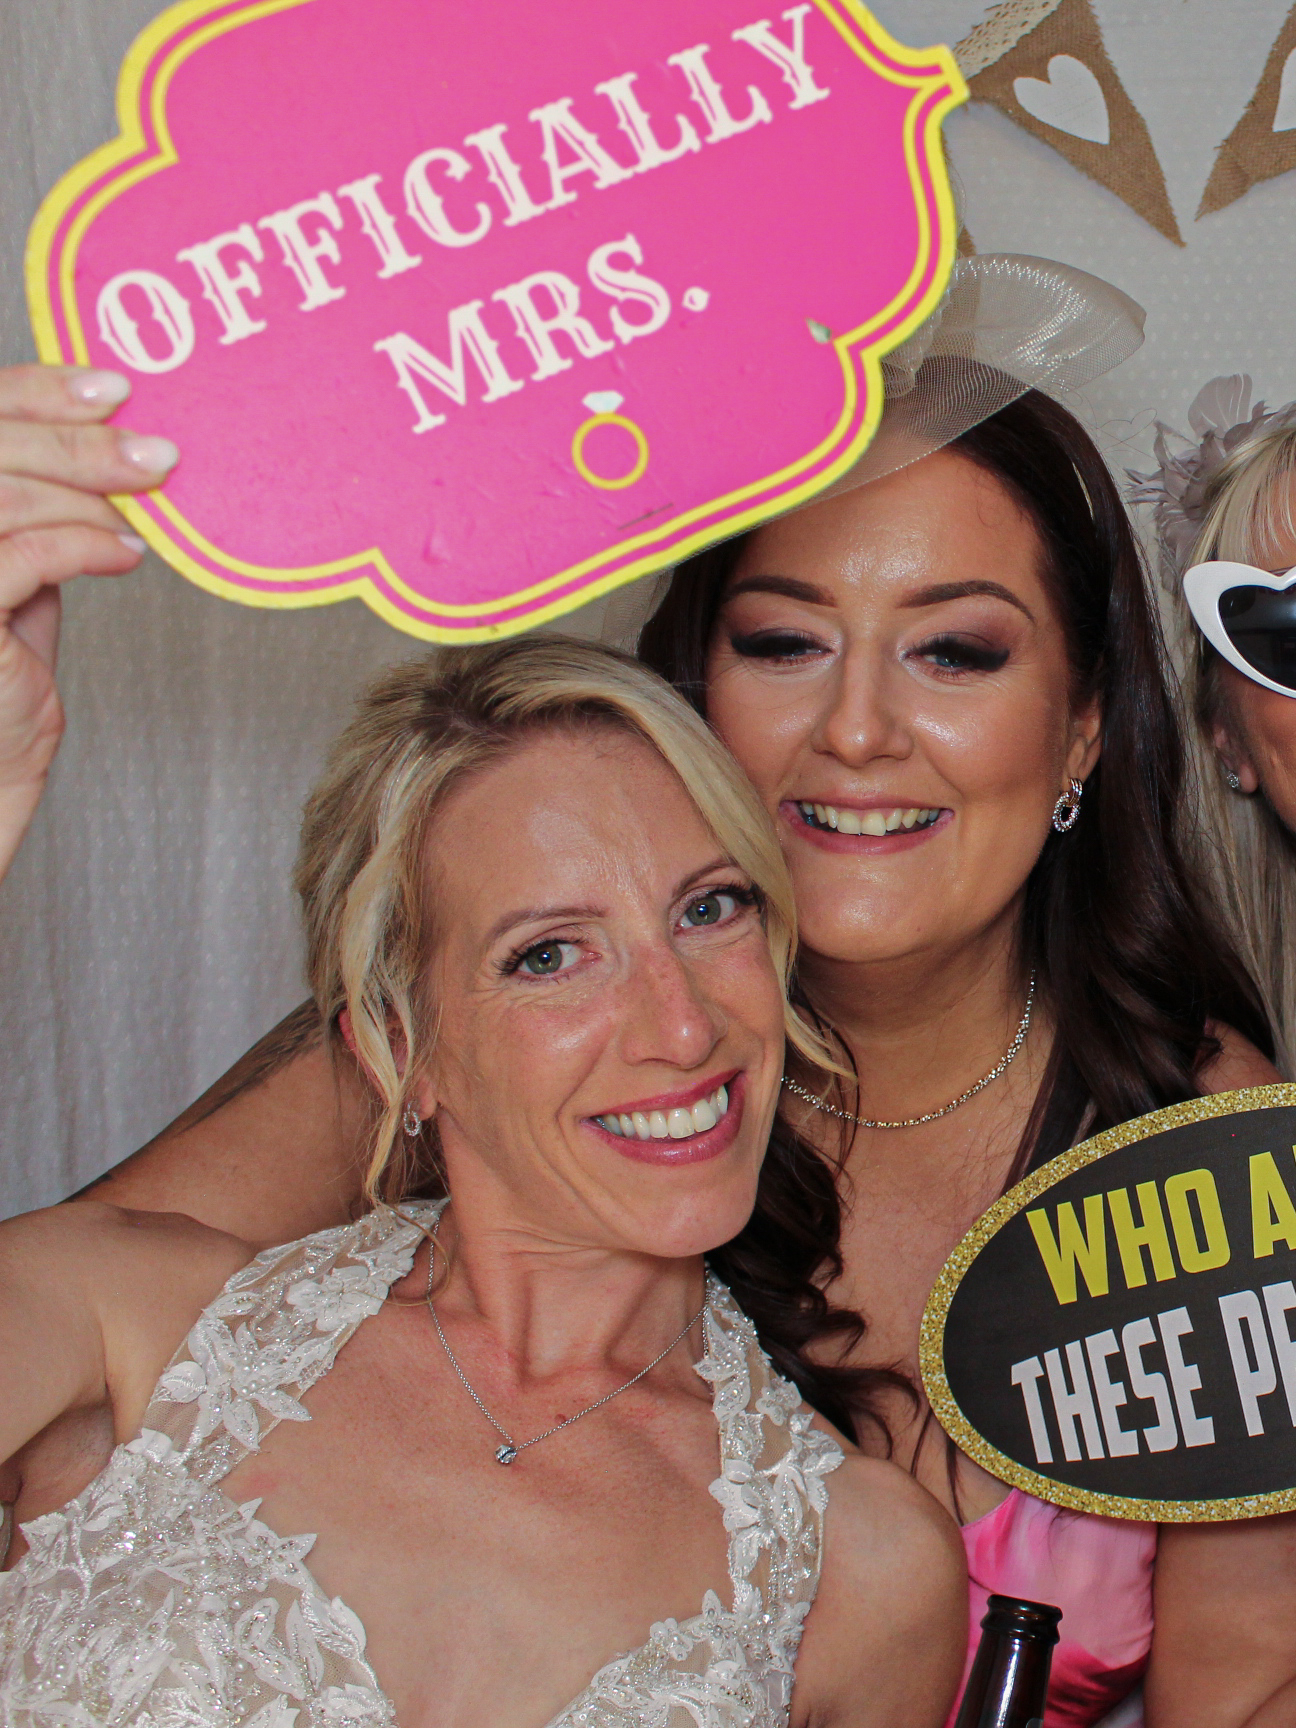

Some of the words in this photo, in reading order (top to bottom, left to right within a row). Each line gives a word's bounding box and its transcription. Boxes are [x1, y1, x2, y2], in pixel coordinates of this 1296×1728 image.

[97, 6, 830, 373] OFFICIALLY
[374, 234, 710, 434] MRS.
[1027, 1169, 1231, 1305] WHO
[1012, 1307, 1215, 1463] THESE
